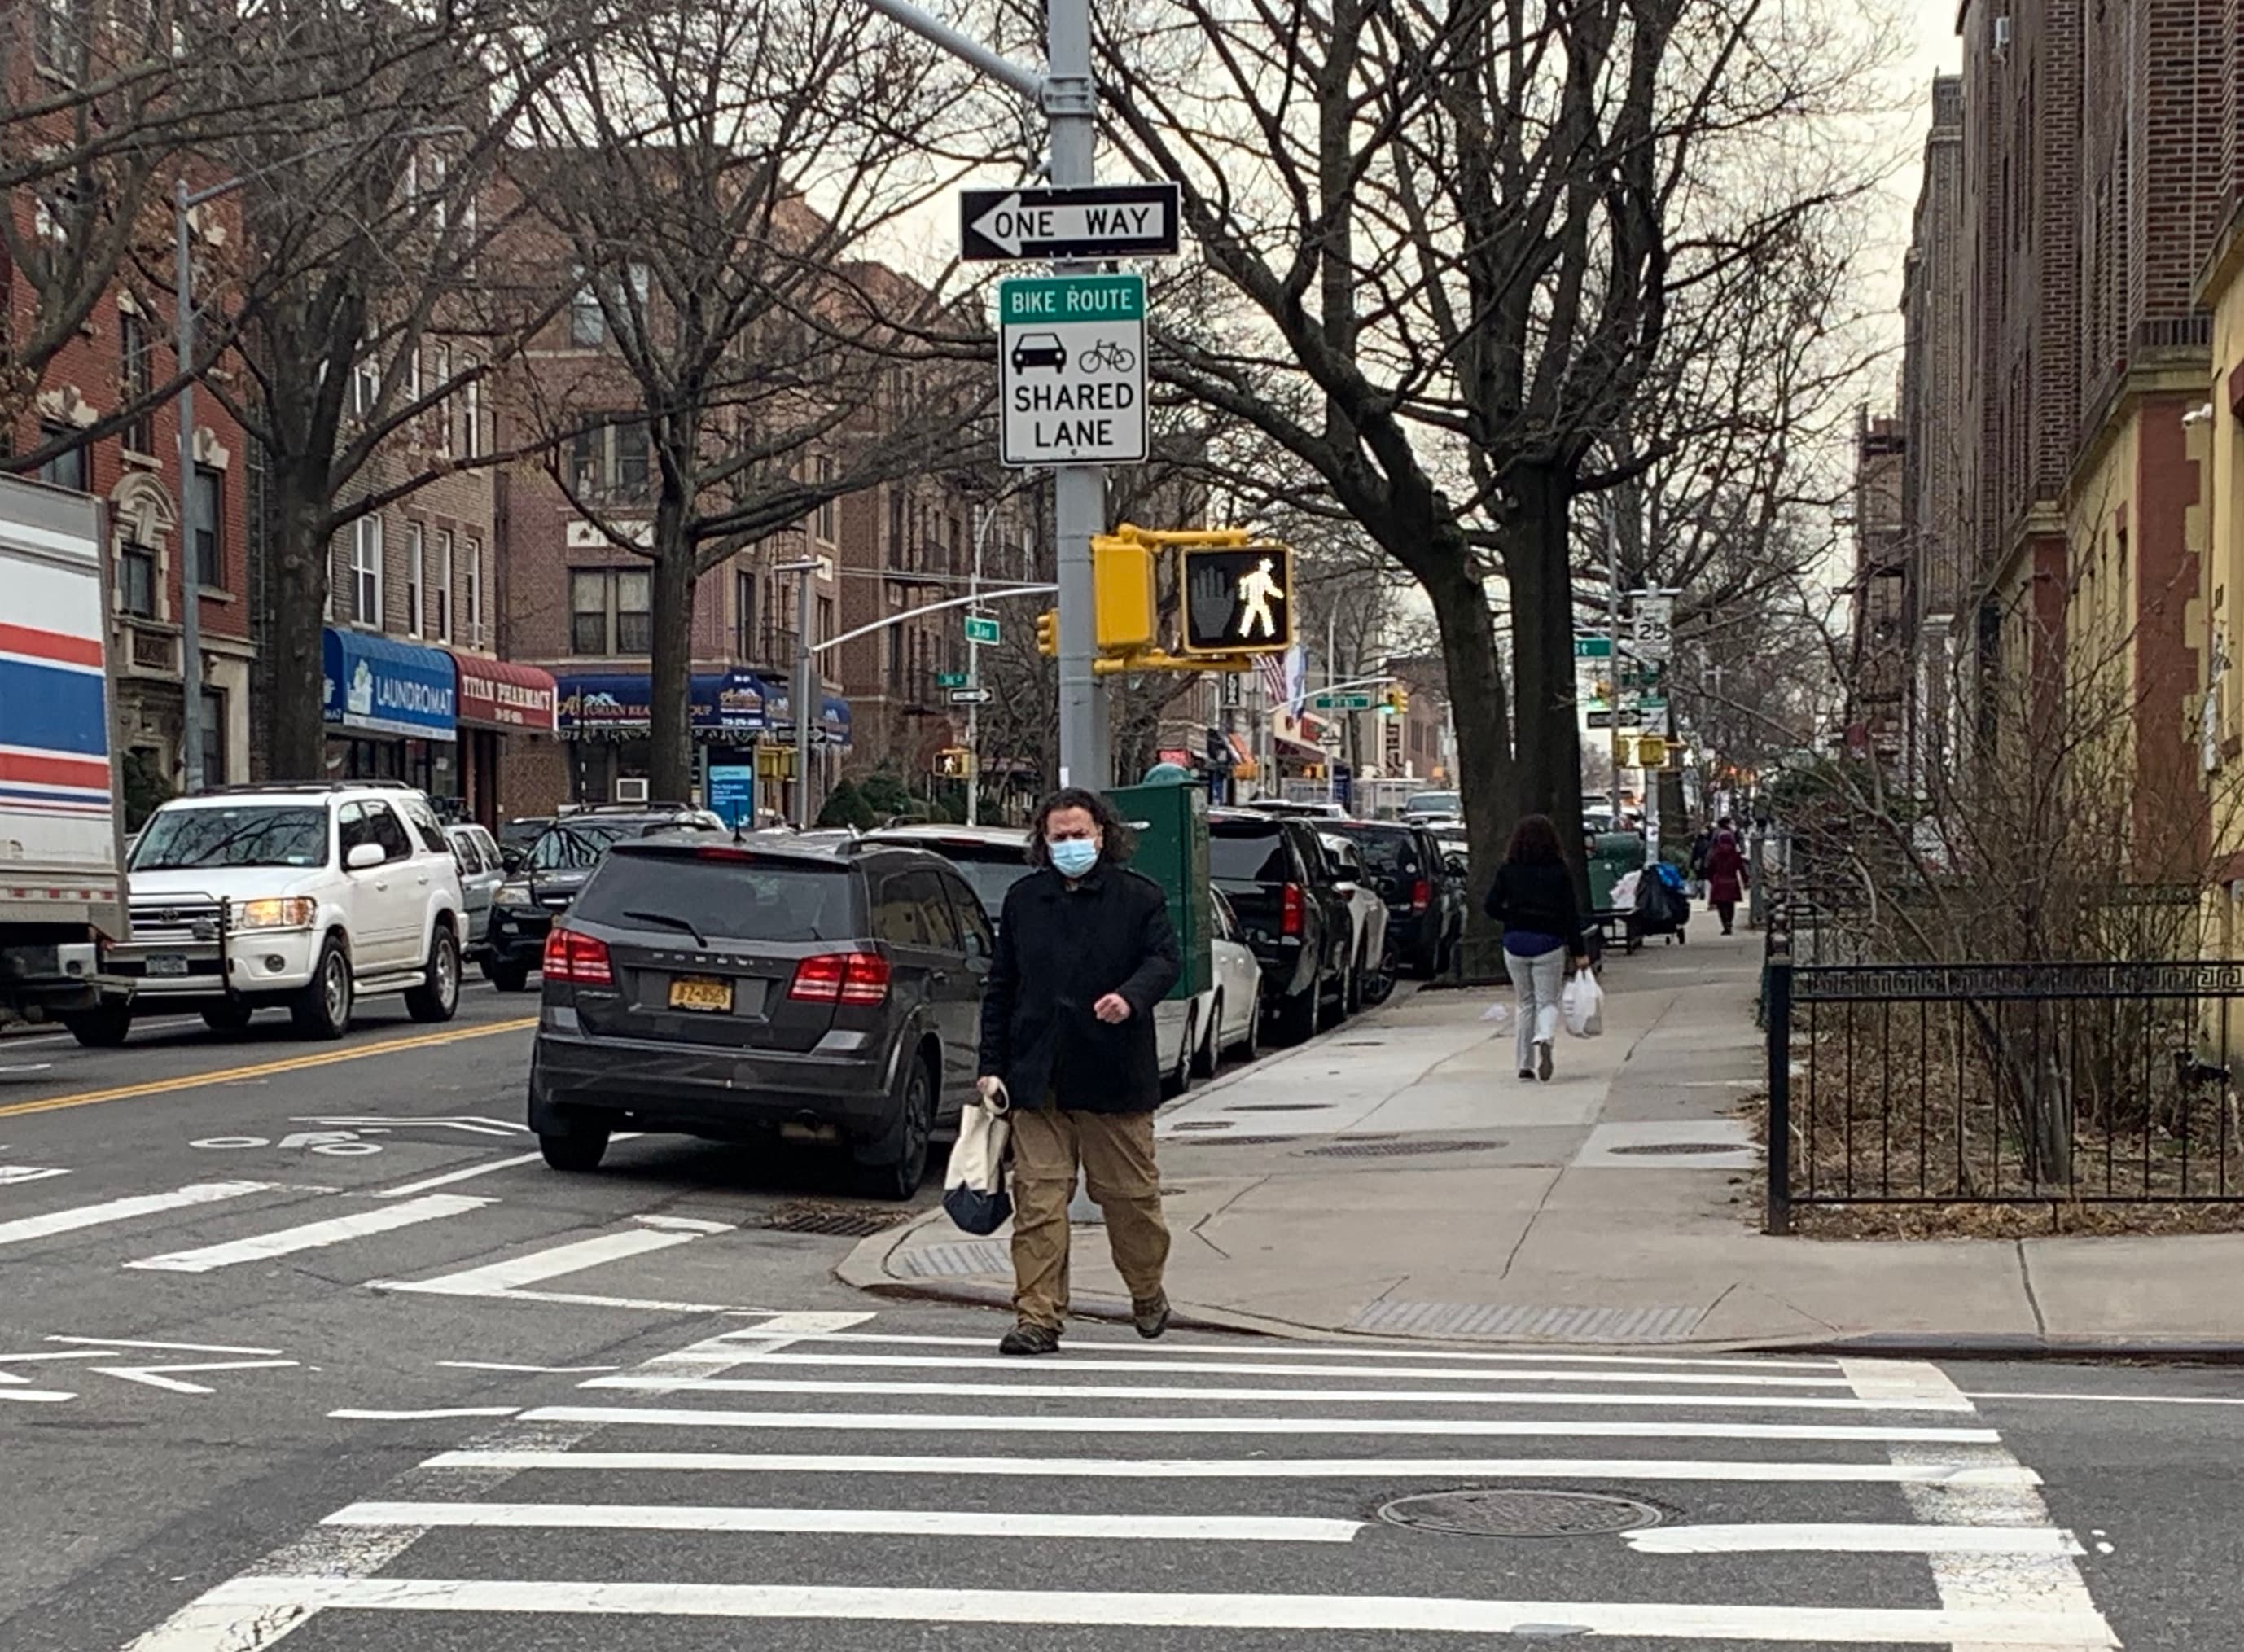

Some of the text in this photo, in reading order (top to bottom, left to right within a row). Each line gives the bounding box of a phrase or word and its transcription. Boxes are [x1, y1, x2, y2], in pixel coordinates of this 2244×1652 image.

[994, 207, 1150, 239] ONE WAY
[1011, 288, 1133, 313] BIKE ROUTE
[1014, 382, 1134, 412] SHARED
[1034, 419, 1114, 448] LANE
[1638, 623, 1667, 640] 25
[375, 676, 454, 716] LAUNDROMAT
[462, 674, 551, 711] TITAN PHARMACY
